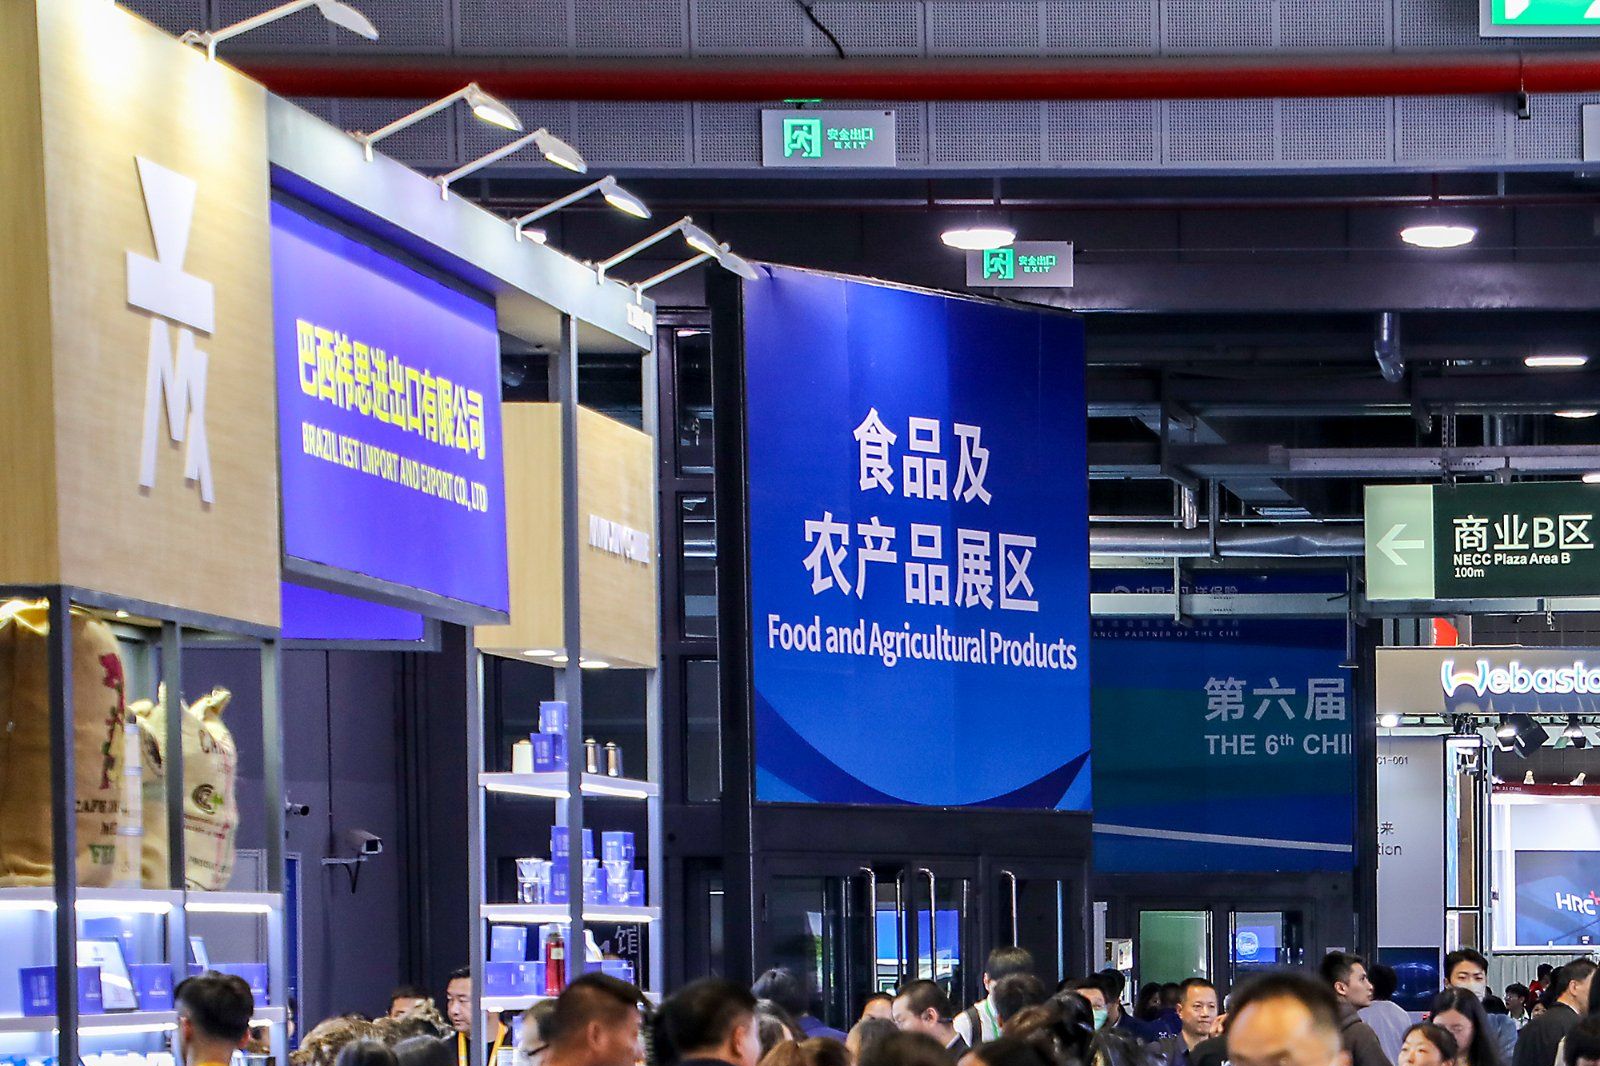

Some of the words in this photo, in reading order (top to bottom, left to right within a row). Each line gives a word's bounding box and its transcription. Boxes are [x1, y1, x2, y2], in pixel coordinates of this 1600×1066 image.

[827, 128, 874, 141] 安全出口
[1018, 255, 1056, 266] 安全出口
[853, 407, 992, 506] 食品及
[400, 456, 420, 490] AND
[421, 463, 453, 501] EXPORT
[471, 481, 488, 513] LTD
[1453, 514, 1595, 553] 商业B区
[802, 511, 1039, 612] 农产品展区
[1453, 553, 1492, 566] NECC
[1494, 553, 1528, 565] Plaza
[1530, 552, 1559, 564] Area
[1561, 552, 1571, 564] B
[1454, 567, 1485, 578] 100m
[768, 614, 820, 650] Food
[826, 619, 865, 655] and
[869, 622, 987, 668] Agricultural
[990, 632, 1077, 670] Products
[1125, 630, 1171, 638] PARTNER
[1195, 630, 1213, 638] THE
[1204, 677, 1346, 722] 第六届
[1204, 735, 1256, 755] THE
[1264, 733, 1294, 755] 6th
[1302, 734, 1352, 755] CHI
